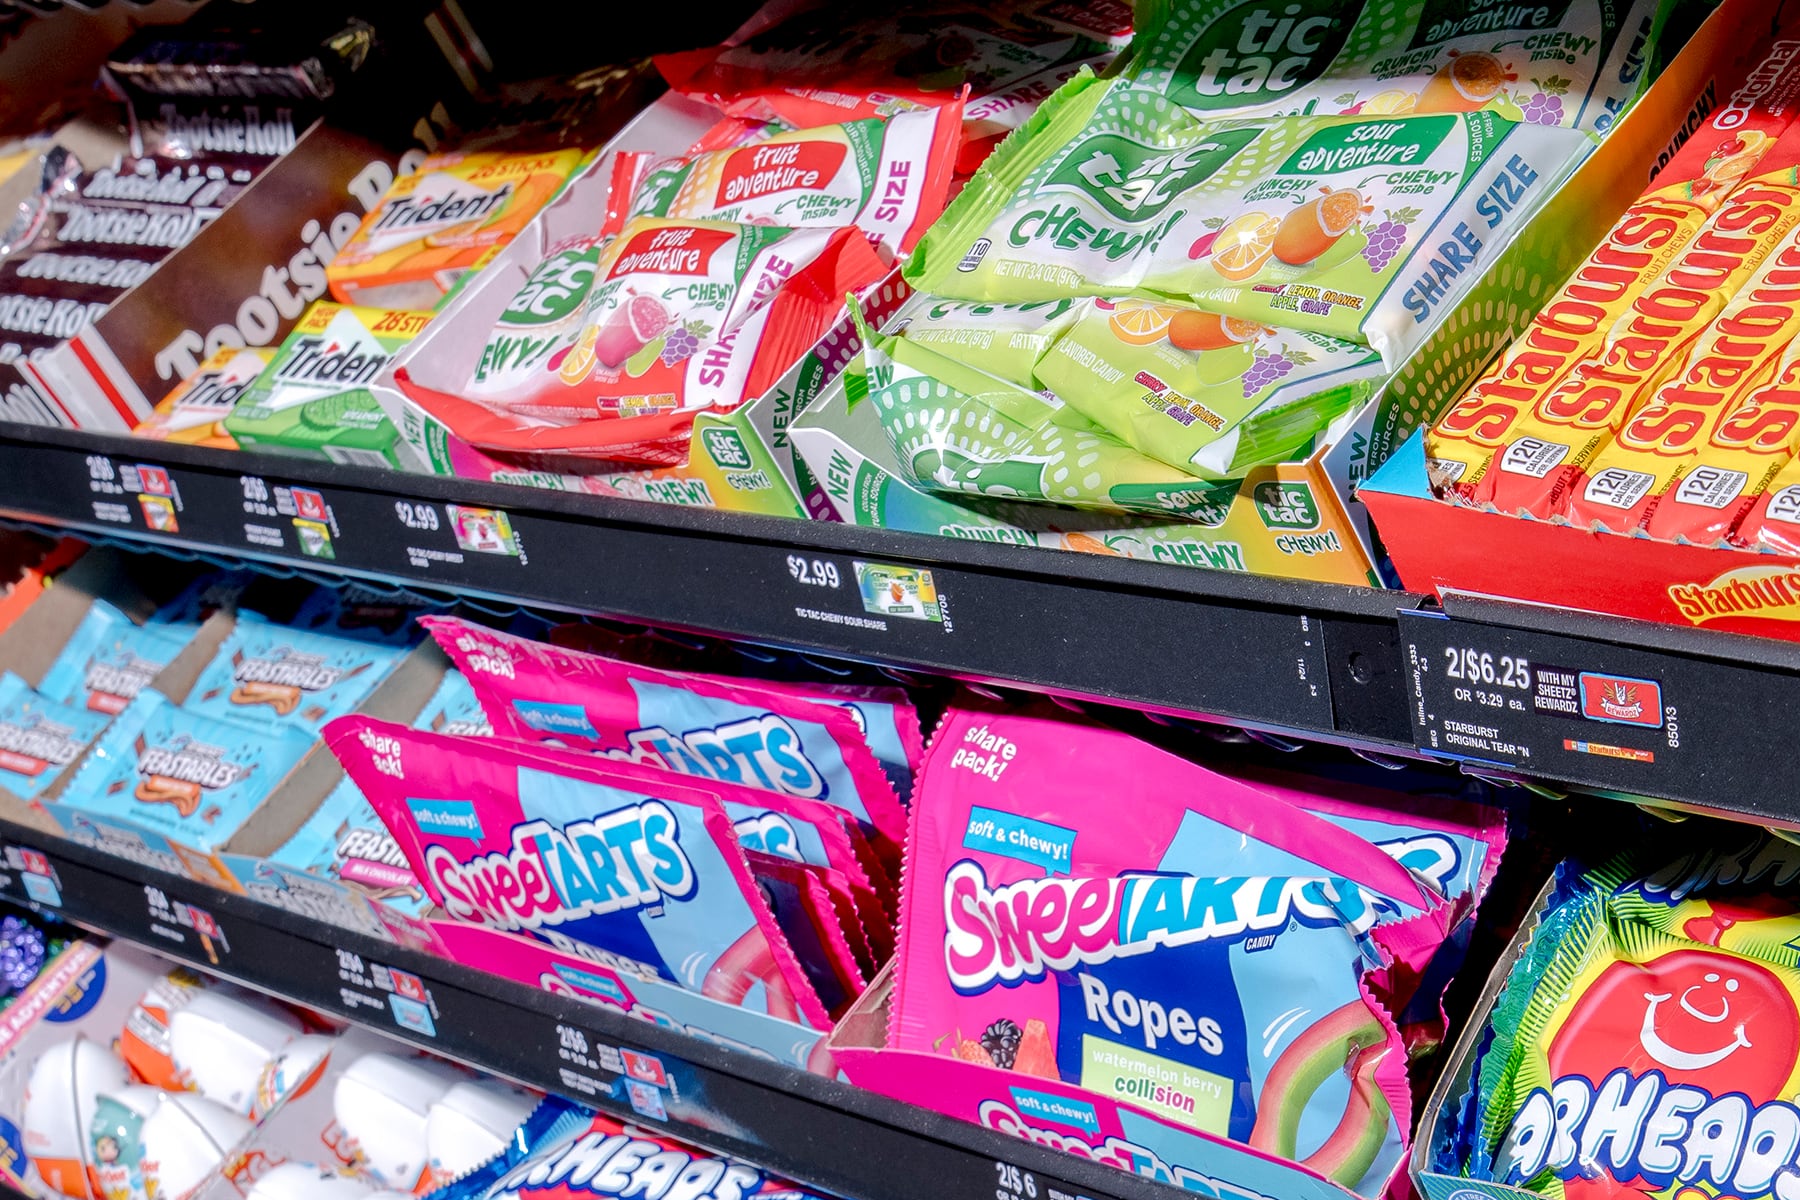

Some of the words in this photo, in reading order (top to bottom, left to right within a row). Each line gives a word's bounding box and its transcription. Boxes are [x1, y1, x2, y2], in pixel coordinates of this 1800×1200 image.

[1240, 3, 1331, 53] tic
[1522, 29, 1598, 57] CHEWY
[1194, 50, 1312, 99] tac
[1370, 46, 1444, 76] CRUNCHY
[1344, 122, 1407, 144] sour
[753, 144, 801, 168] fruit
[1297, 140, 1424, 172] adventure
[725, 166, 820, 202] adventure
[874, 160, 912, 223] SIZE
[1385, 168, 1460, 187] CHEWY
[374, 181, 514, 233] Trident
[796, 194, 857, 211] CHEWY
[649, 228, 690, 249] fruit
[1402, 222, 1484, 325] SHARE
[1476, 153, 1540, 231] SIZE
[616, 245, 701, 272] adventure
[1639, 256, 1667, 286] FRUIT
[1663, 227, 1693, 259] CHEWS
[688, 283, 734, 300] CHEWY
[1321, 291, 1363, 310] ORANGE,
[1300, 299, 1331, 316] GRAPE
[1441, 200, 1690, 441] Starburst
[1541, 187, 1798, 435] Starburst
[772, 388, 792, 449] NEW
[712, 429, 738, 450] tic
[1508, 439, 1543, 467] 120
[715, 448, 749, 469] tac
[1267, 481, 1306, 508] tic
[1590, 471, 1628, 499] 120
[1680, 472, 1718, 503] 120
[1264, 503, 1318, 529] tac
[1274, 532, 1345, 556] CHEWY!
[788, 555, 841, 588] $2.99
[938, 593, 954, 634] 127708
[234, 655, 344, 692] FEASTABLES
[1445, 647, 1531, 690] 2/$6.25
[1537, 670, 1558, 686] WITH
[1558, 674, 1576, 688] MY
[1454, 688, 1472, 703] OR
[1535, 696, 1578, 714] REWARDZ
[964, 724, 1017, 761] share
[1444, 720, 1499, 739] STARBURST
[1666, 705, 1680, 749] 85013
[138, 748, 242, 789] FEASTABLES
[950, 746, 1008, 782] pack!
[968, 820, 994, 842] soft
[996, 829, 1006, 843] &
[1008, 827, 1069, 859] chewy!
[1246, 934, 1276, 952] CANDY
[1079, 973, 1225, 1056] Ropes
[1091, 1047, 1181, 1085] watermelon
[1182, 1074, 1222, 1099] berry
[1113, 1074, 1196, 1115] collision
